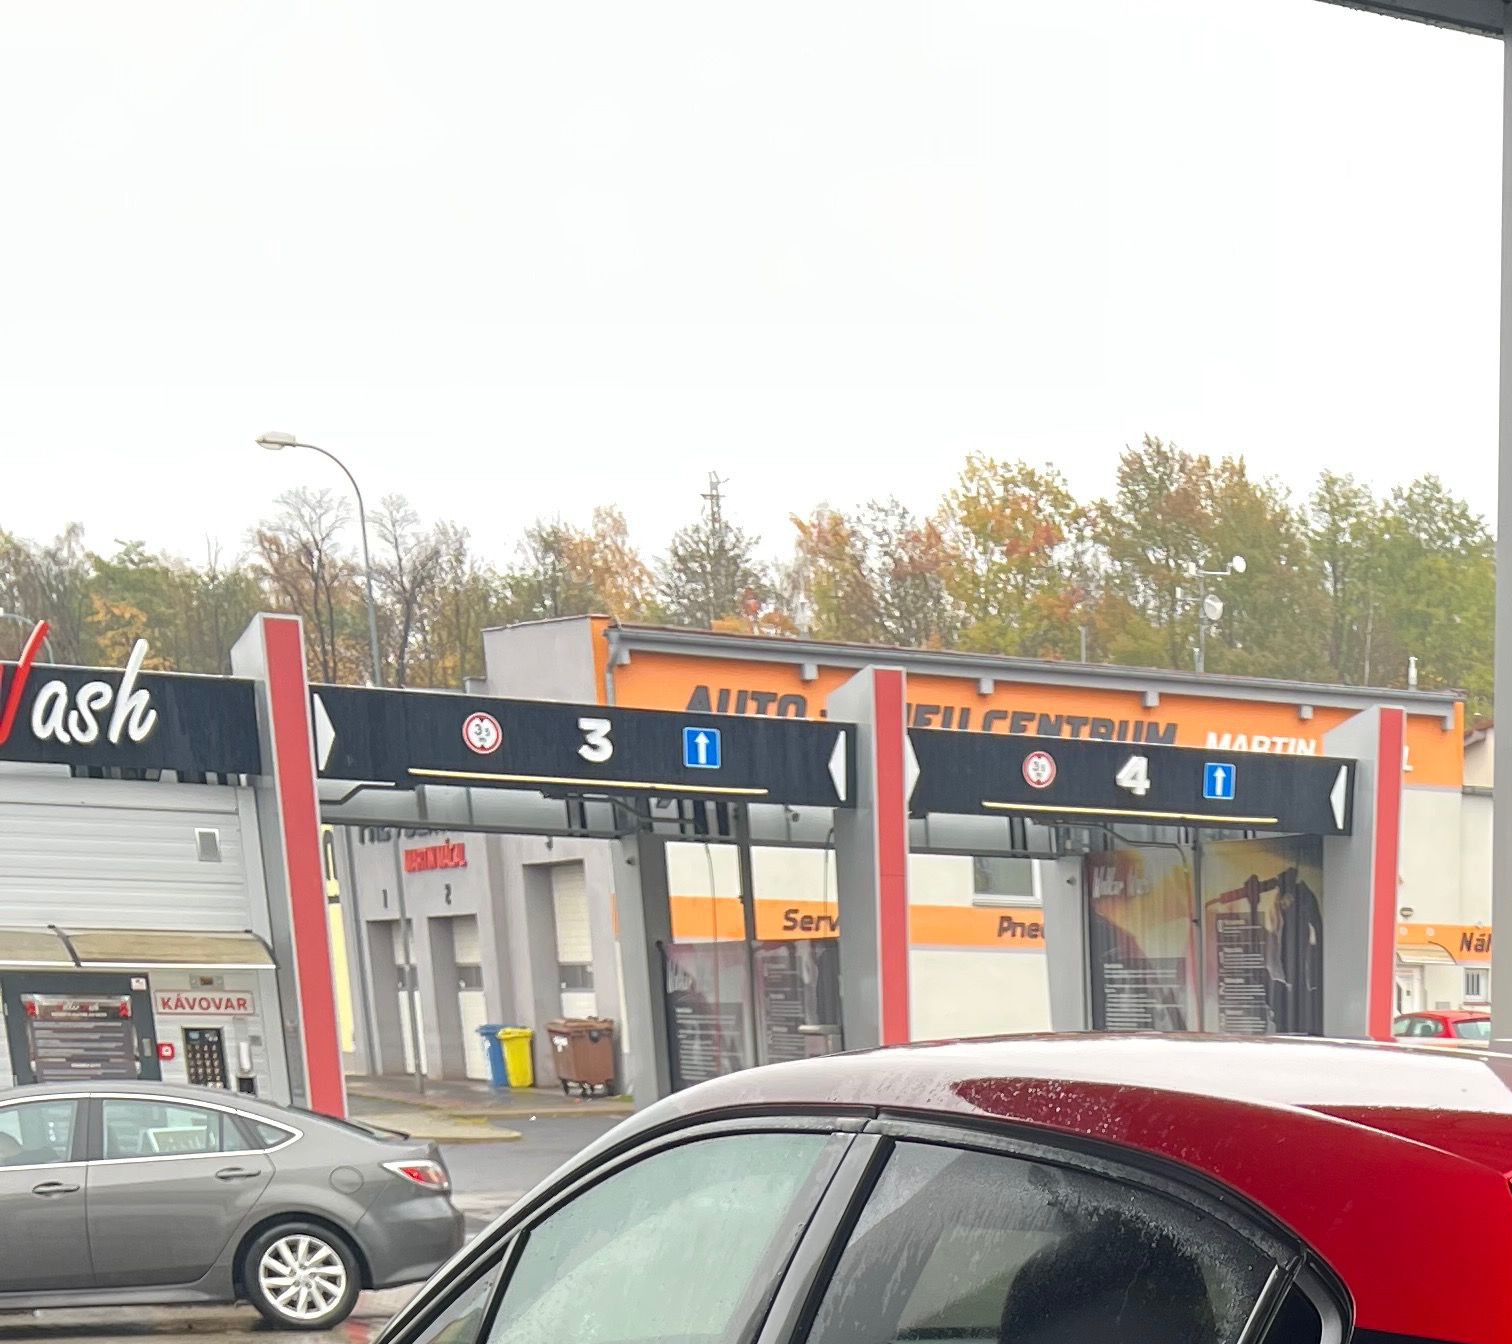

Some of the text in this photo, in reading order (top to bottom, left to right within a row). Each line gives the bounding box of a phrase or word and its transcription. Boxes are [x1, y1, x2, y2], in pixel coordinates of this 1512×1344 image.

[576, 716, 615, 764] 3
[1115, 754, 1152, 797] 4
[160, 993, 248, 1012] KÁVOVAR
